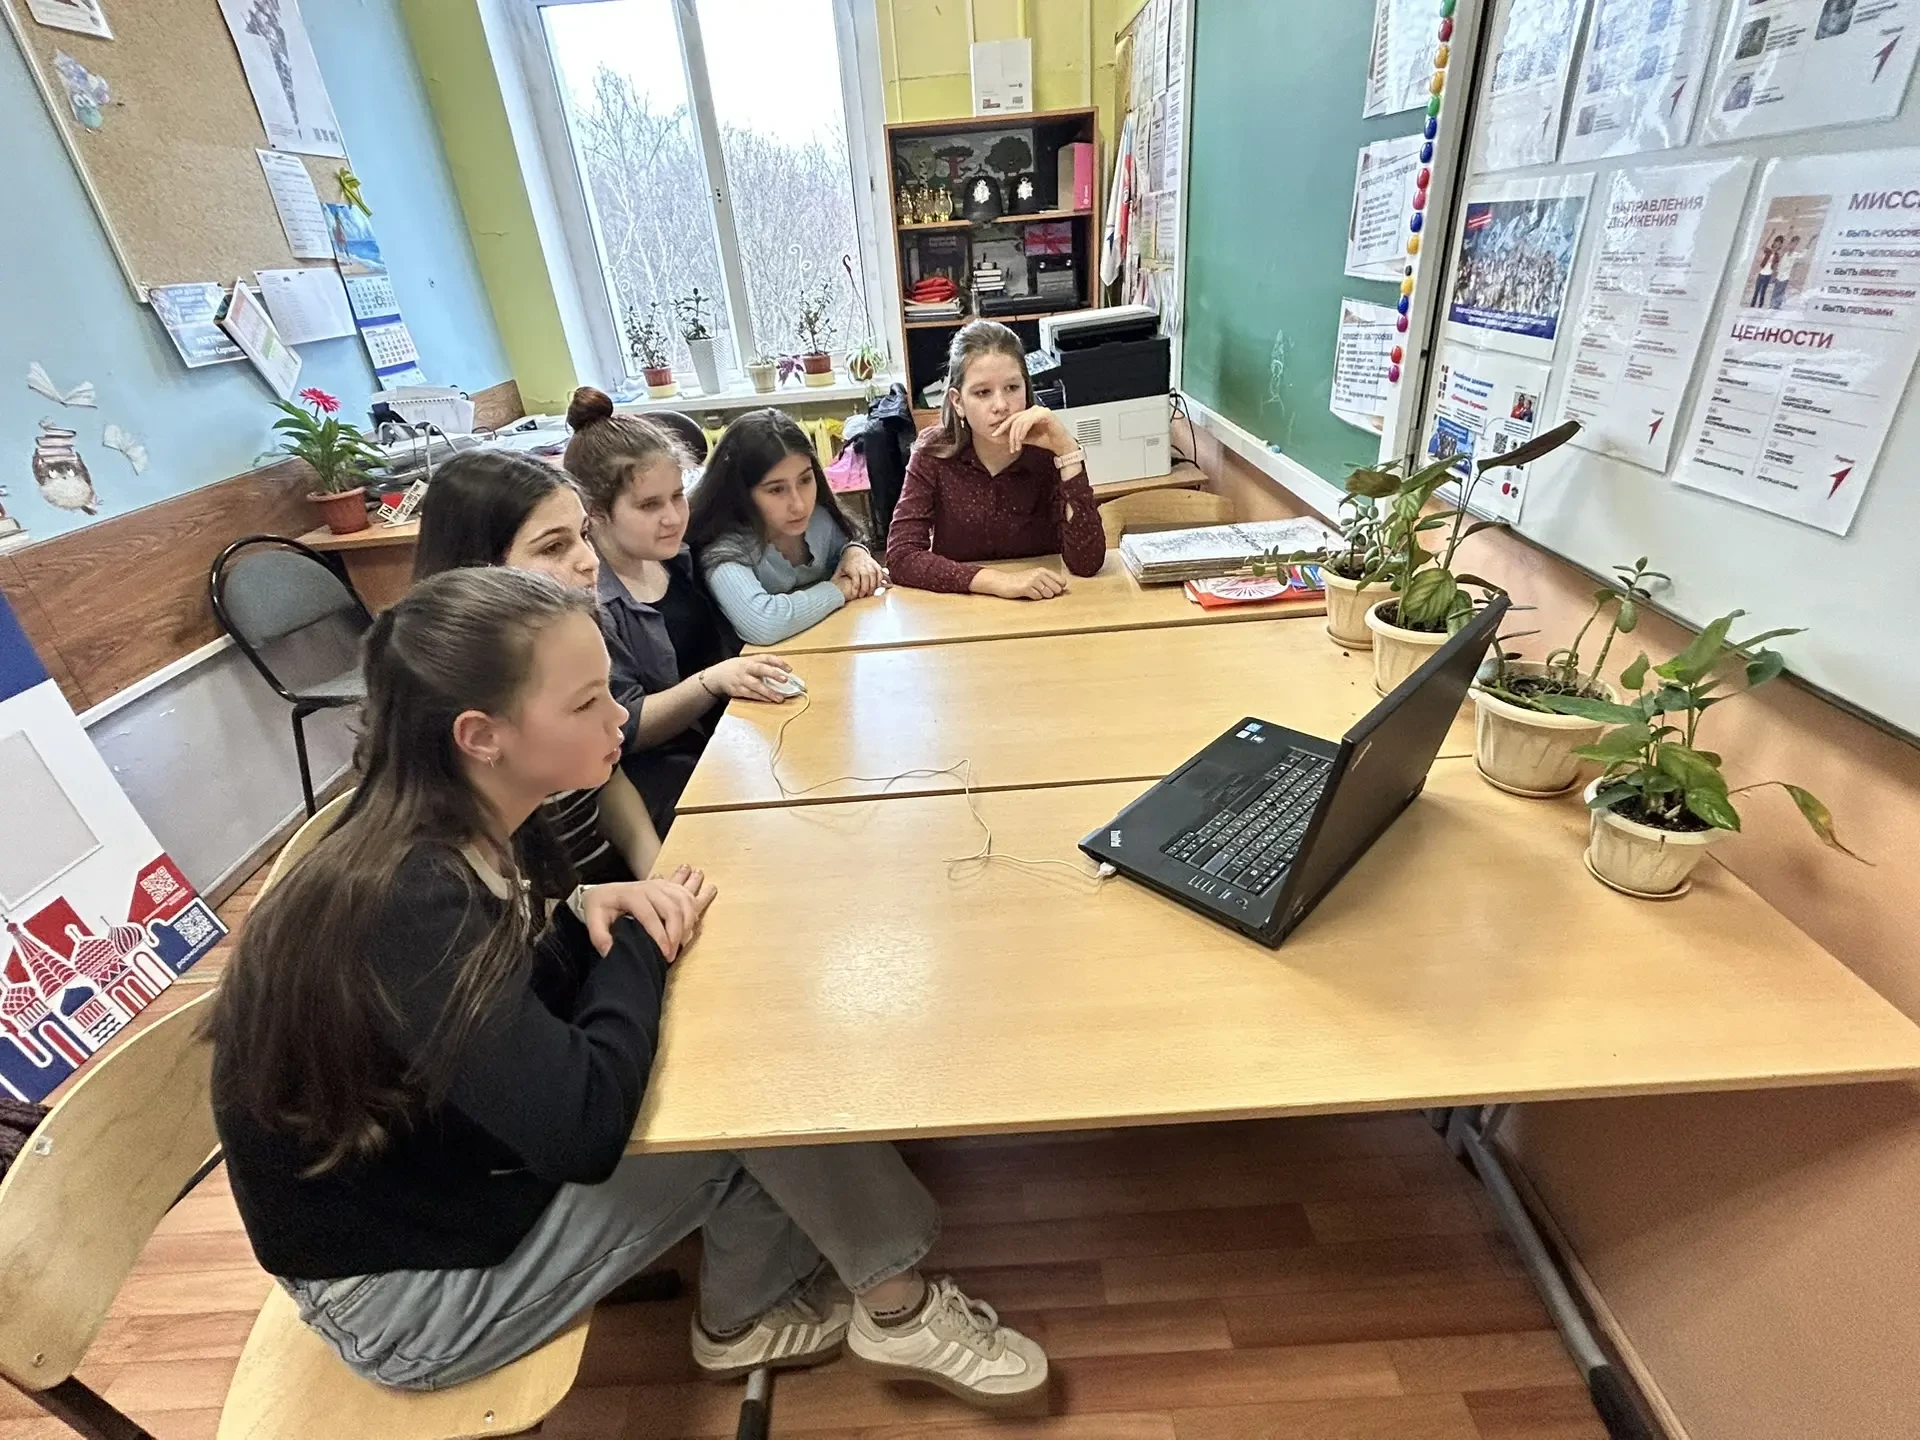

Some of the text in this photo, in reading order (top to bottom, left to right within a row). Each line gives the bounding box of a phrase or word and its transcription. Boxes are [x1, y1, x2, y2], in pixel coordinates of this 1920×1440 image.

[1612, 196, 1703, 214] НАПРАВЛЕНИЯ
[1848, 190, 1920, 211] МИСС
[1608, 213, 1678, 230] ДВИЖЕНИЯ
[1833, 267, 1899, 278] БЫТЬ ВМЕСТЕ
[1822, 303, 1895, 317] БЫТЬ ПЕРВЫМИ
[1731, 323, 1834, 349] ЦЕННОСТИ
[380, 505, 393, 518] ТЫ
